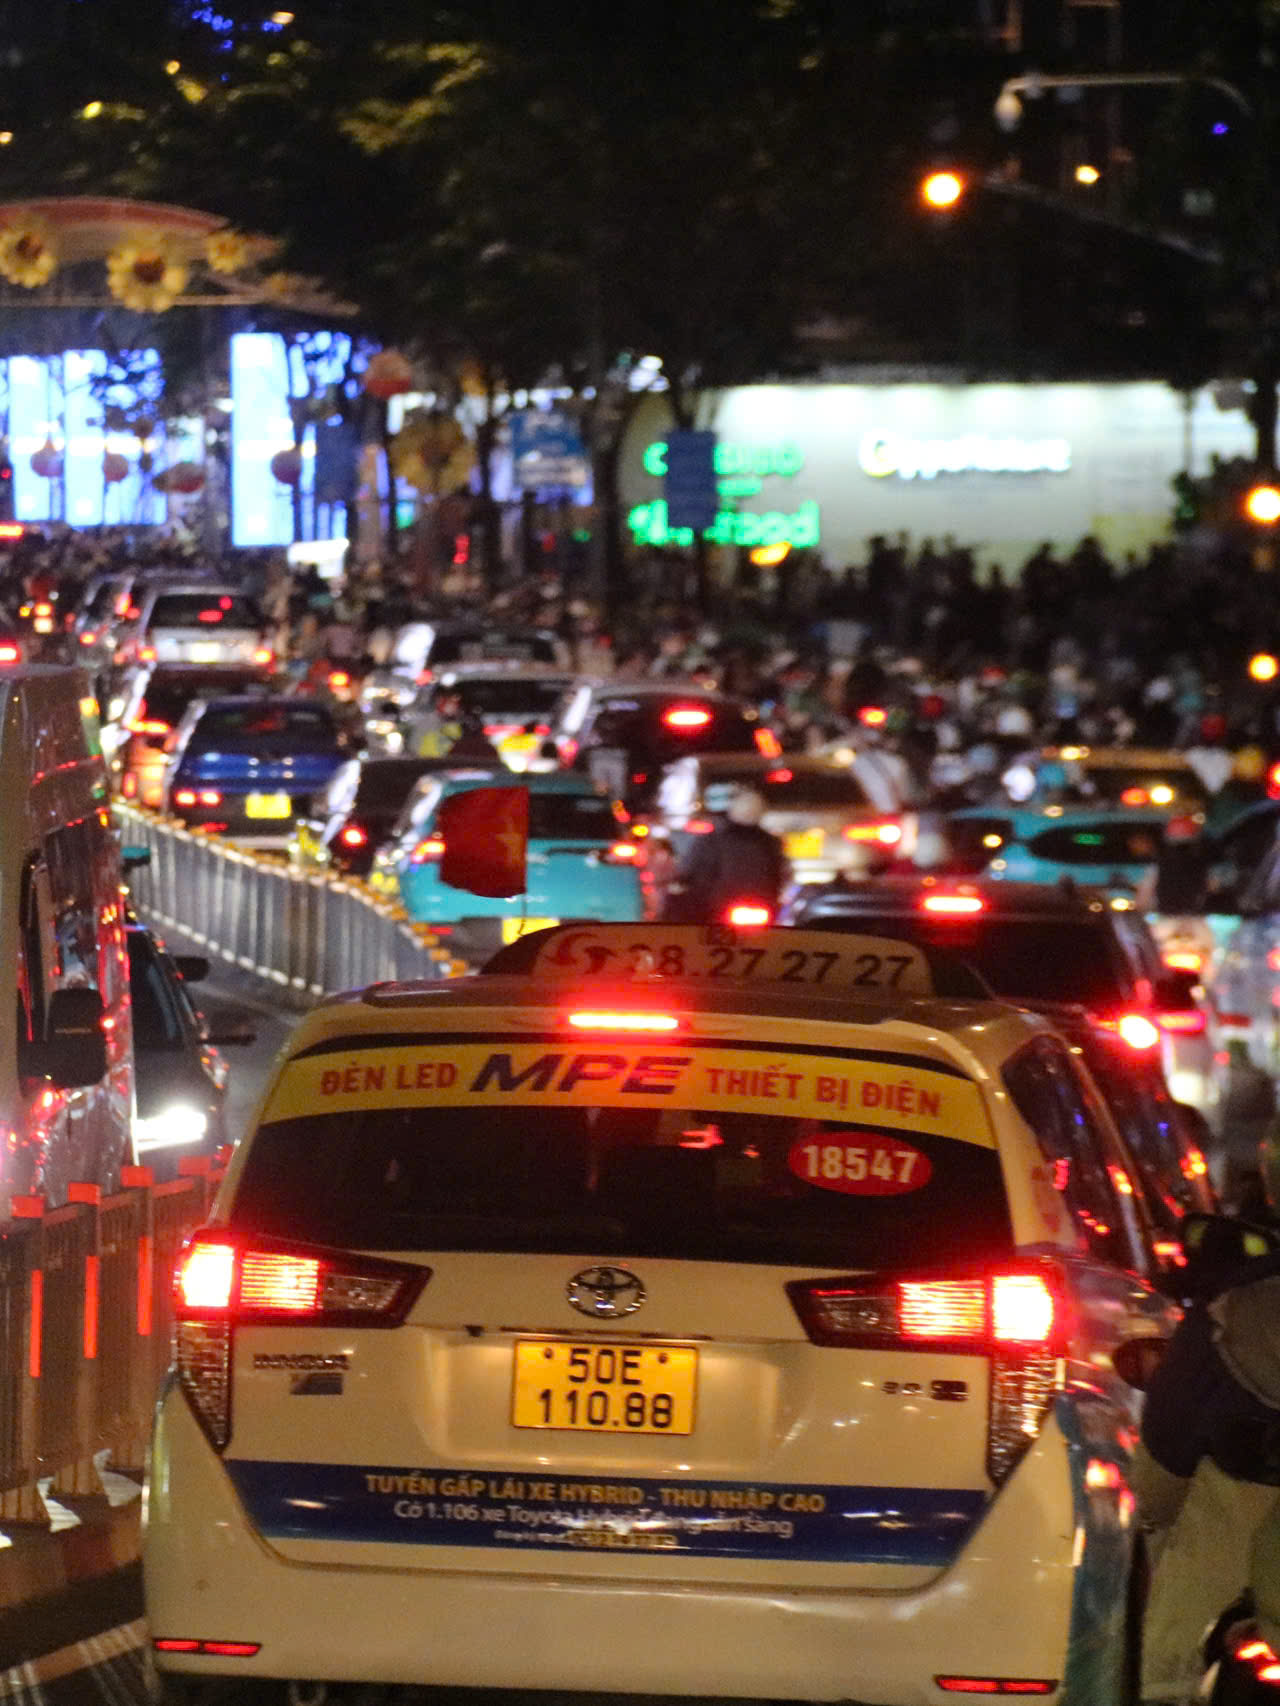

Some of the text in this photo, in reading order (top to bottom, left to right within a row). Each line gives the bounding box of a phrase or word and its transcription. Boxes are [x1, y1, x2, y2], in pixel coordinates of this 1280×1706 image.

[781, 950, 840, 983] 27
[853, 953, 914, 987] 27
[320, 1053, 943, 1118] ĐÈN LED MPE THIẾT BỊ ĐIỆN
[802, 1144, 920, 1184] 18547
[568, 1348, 643, 1385] 50E
[539, 1388, 673, 1429] 110.88
[439, 1475, 485, 1498] GẤP
[489, 1477, 524, 1500] LÁI
[528, 1482, 558, 1501] XE
[561, 1483, 644, 1505] HYBRID
[659, 1487, 707, 1508] THU
[777, 1493, 825, 1513] CAO
[394, 1500, 423, 1519] Có
[427, 1502, 478, 1521] 1.106
[481, 1507, 504, 1523] xe
[507, 1505, 571, 1528] Toyota
